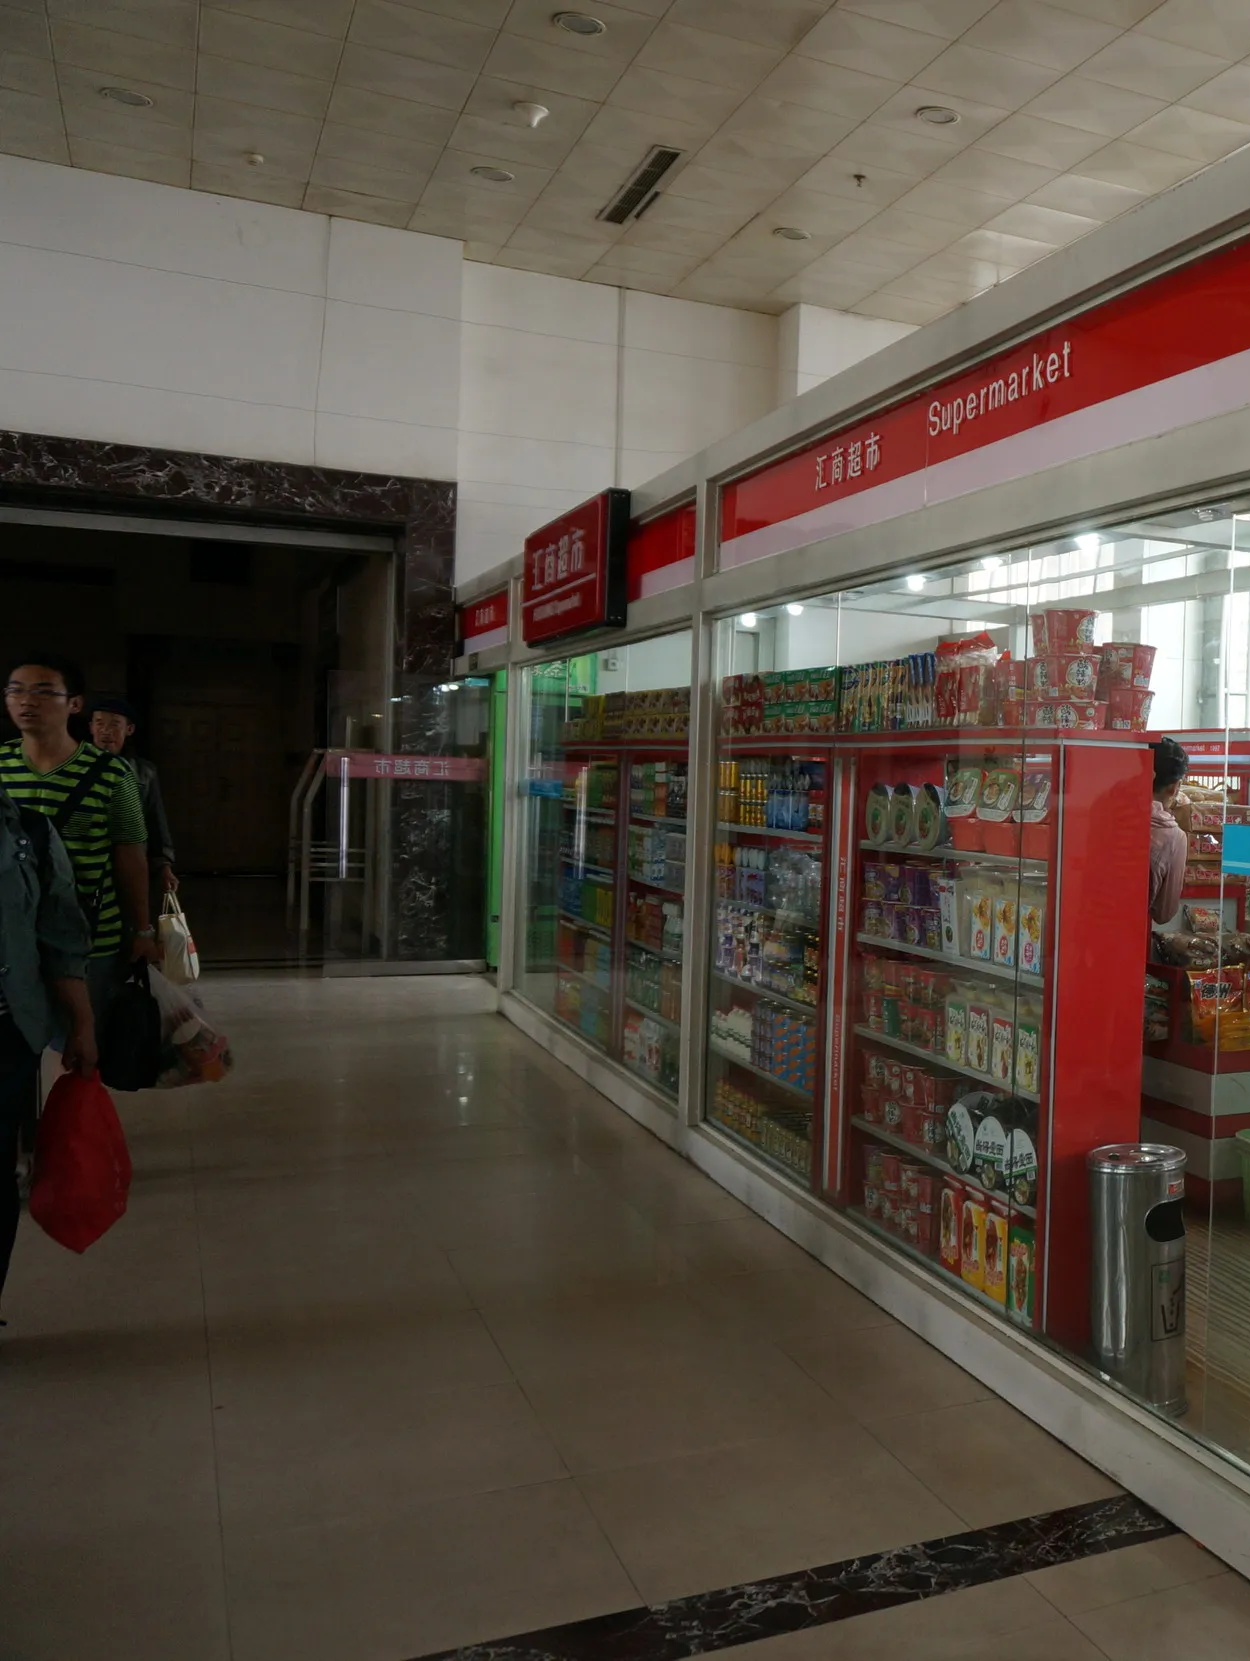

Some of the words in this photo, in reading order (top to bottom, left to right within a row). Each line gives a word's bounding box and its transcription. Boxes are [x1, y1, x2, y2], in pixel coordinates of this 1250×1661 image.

[929, 341, 1072, 436] Supermarket
[815, 432, 881, 491] 汇商超市
